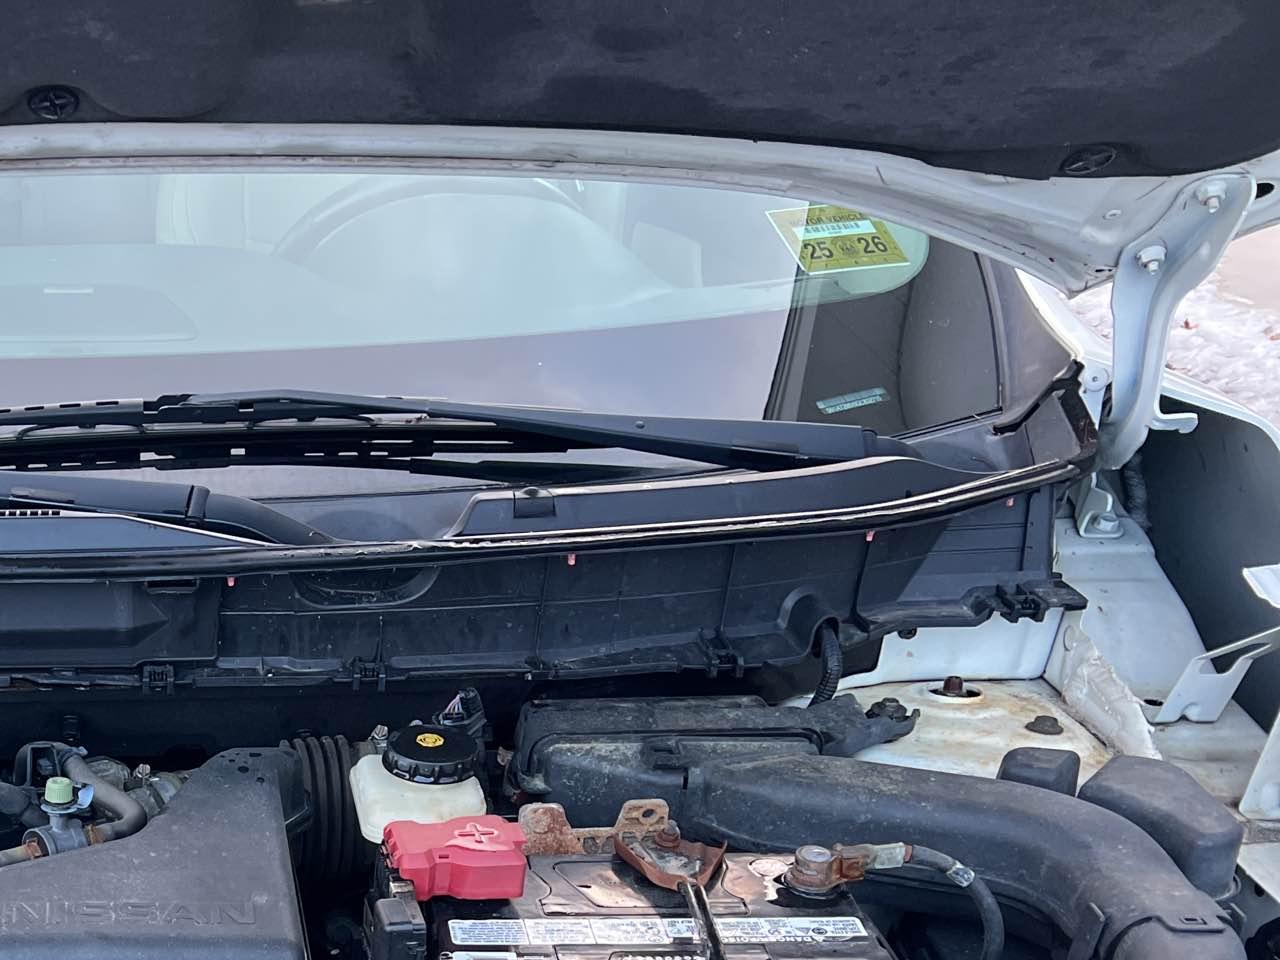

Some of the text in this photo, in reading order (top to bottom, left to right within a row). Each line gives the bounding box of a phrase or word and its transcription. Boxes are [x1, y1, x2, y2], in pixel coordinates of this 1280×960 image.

[803, 241, 834, 260] 25
[857, 235, 889, 253] 26
[3, 897, 257, 927] NISSAN
